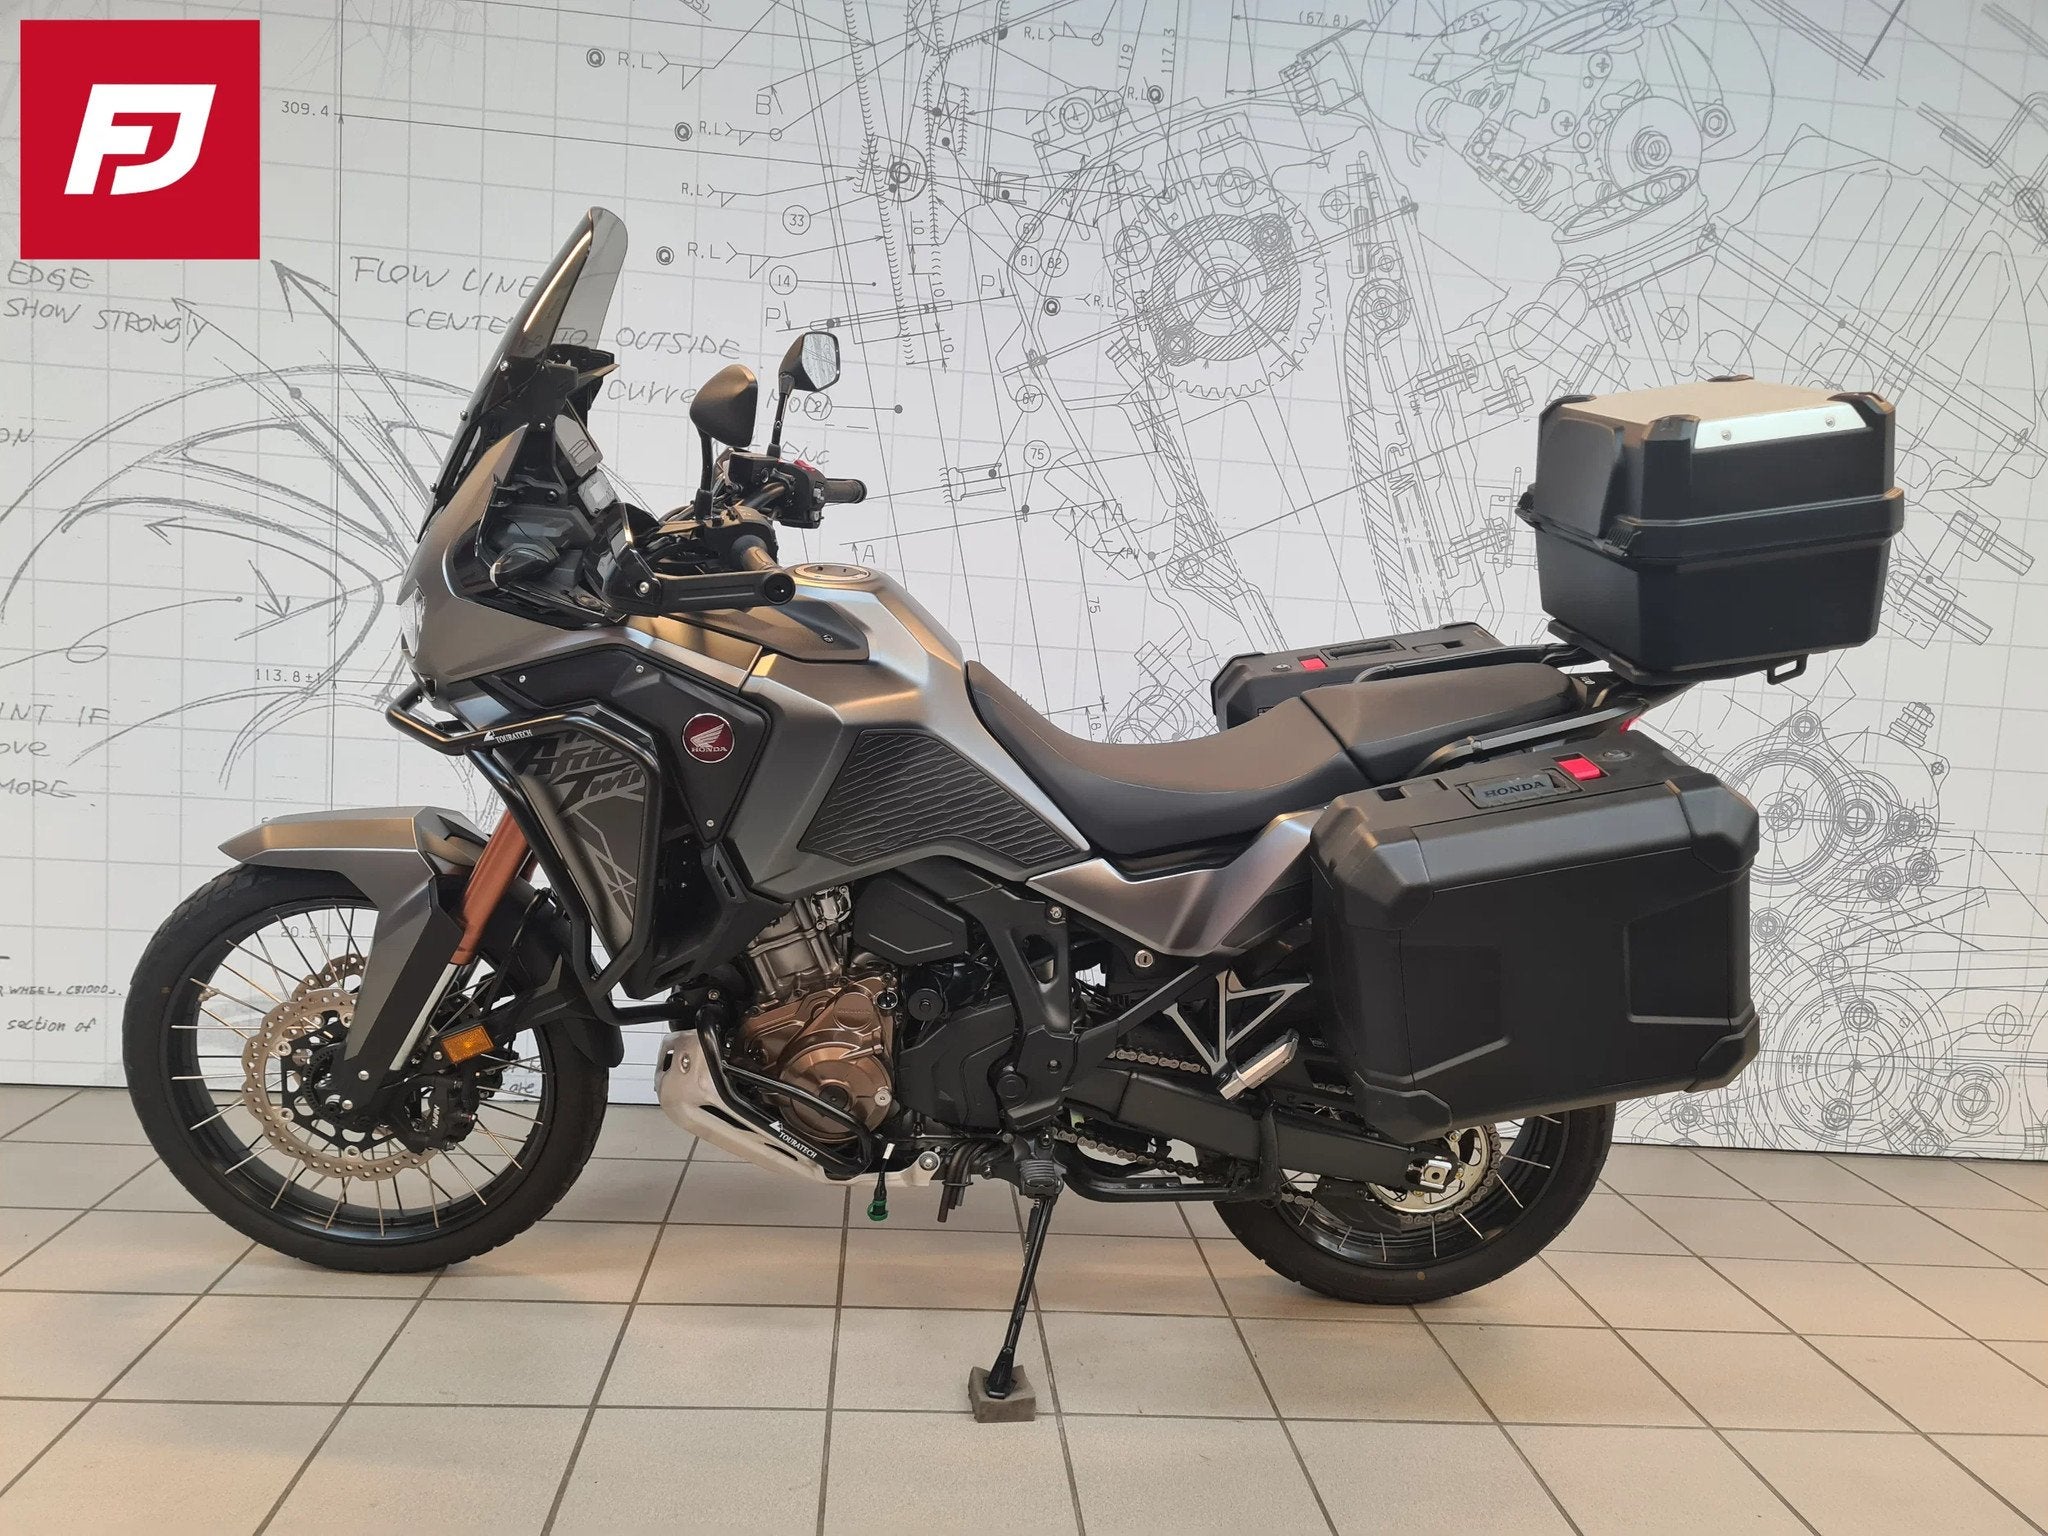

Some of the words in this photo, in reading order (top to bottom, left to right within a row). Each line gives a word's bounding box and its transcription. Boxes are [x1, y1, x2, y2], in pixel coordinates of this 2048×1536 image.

[281, 100, 329, 117] 309.4
[755, 93, 772, 116] B
[789, 213, 805, 228] 33
[1020, 254, 1034, 268] 81
[1047, 257, 1063, 270] 82
[8, 261, 95, 292] EDGE
[350, 255, 450, 289] FLOW
[777, 273, 791, 288] 14
[981, 274, 996, 295] P
[3, 297, 82, 324] SHOW
[765, 307, 782, 327] P
[615, 326, 741, 360] OUTSIDE
[1030, 447, 1045, 461] 75
[862, 544, 876, 564] A
[1088, 596, 1101, 615] 75
[495, 729, 534, 744] TOURATECH
[1484, 781, 1546, 797] HONDA
[7, 1016, 66, 1032] section
[74, 1017, 97, 1032] of
[778, 1130, 818, 1159] TOURATECH
